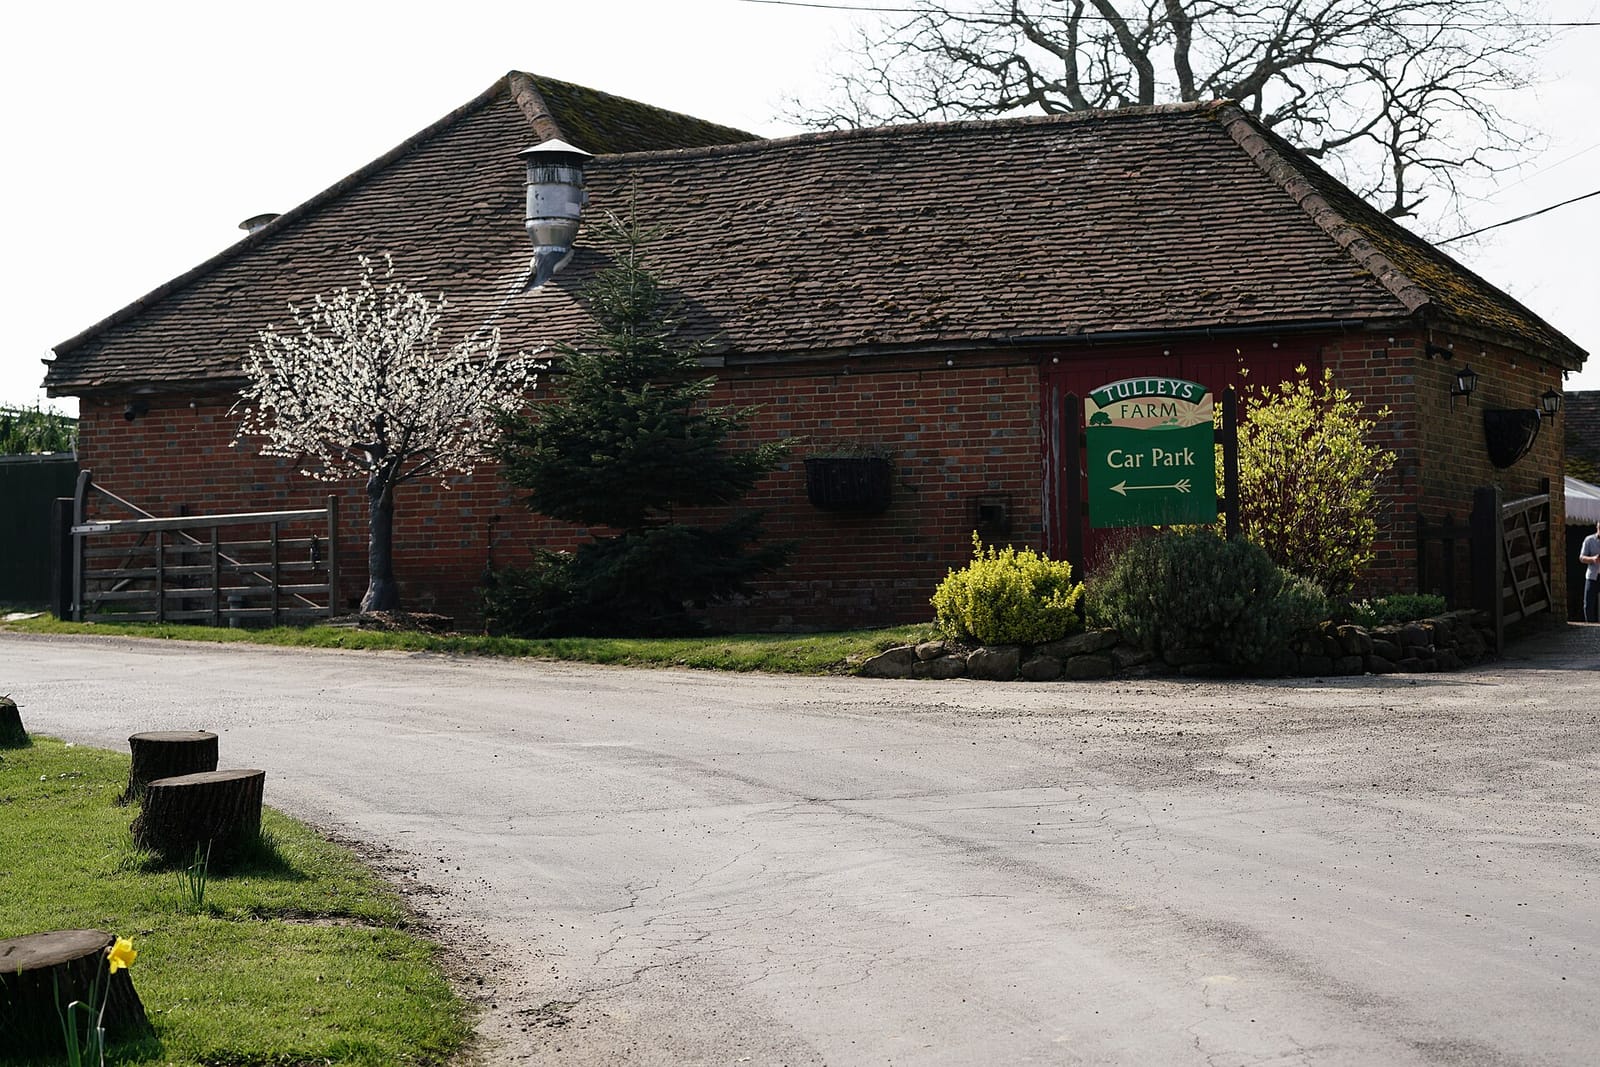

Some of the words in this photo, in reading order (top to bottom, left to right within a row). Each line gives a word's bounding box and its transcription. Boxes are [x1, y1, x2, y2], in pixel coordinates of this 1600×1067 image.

[1103, 381, 1194, 401] TULLEYS
[1121, 402, 1178, 418] FARM
[1107, 449, 1144, 468] Car
[1152, 447, 1196, 467] Park
